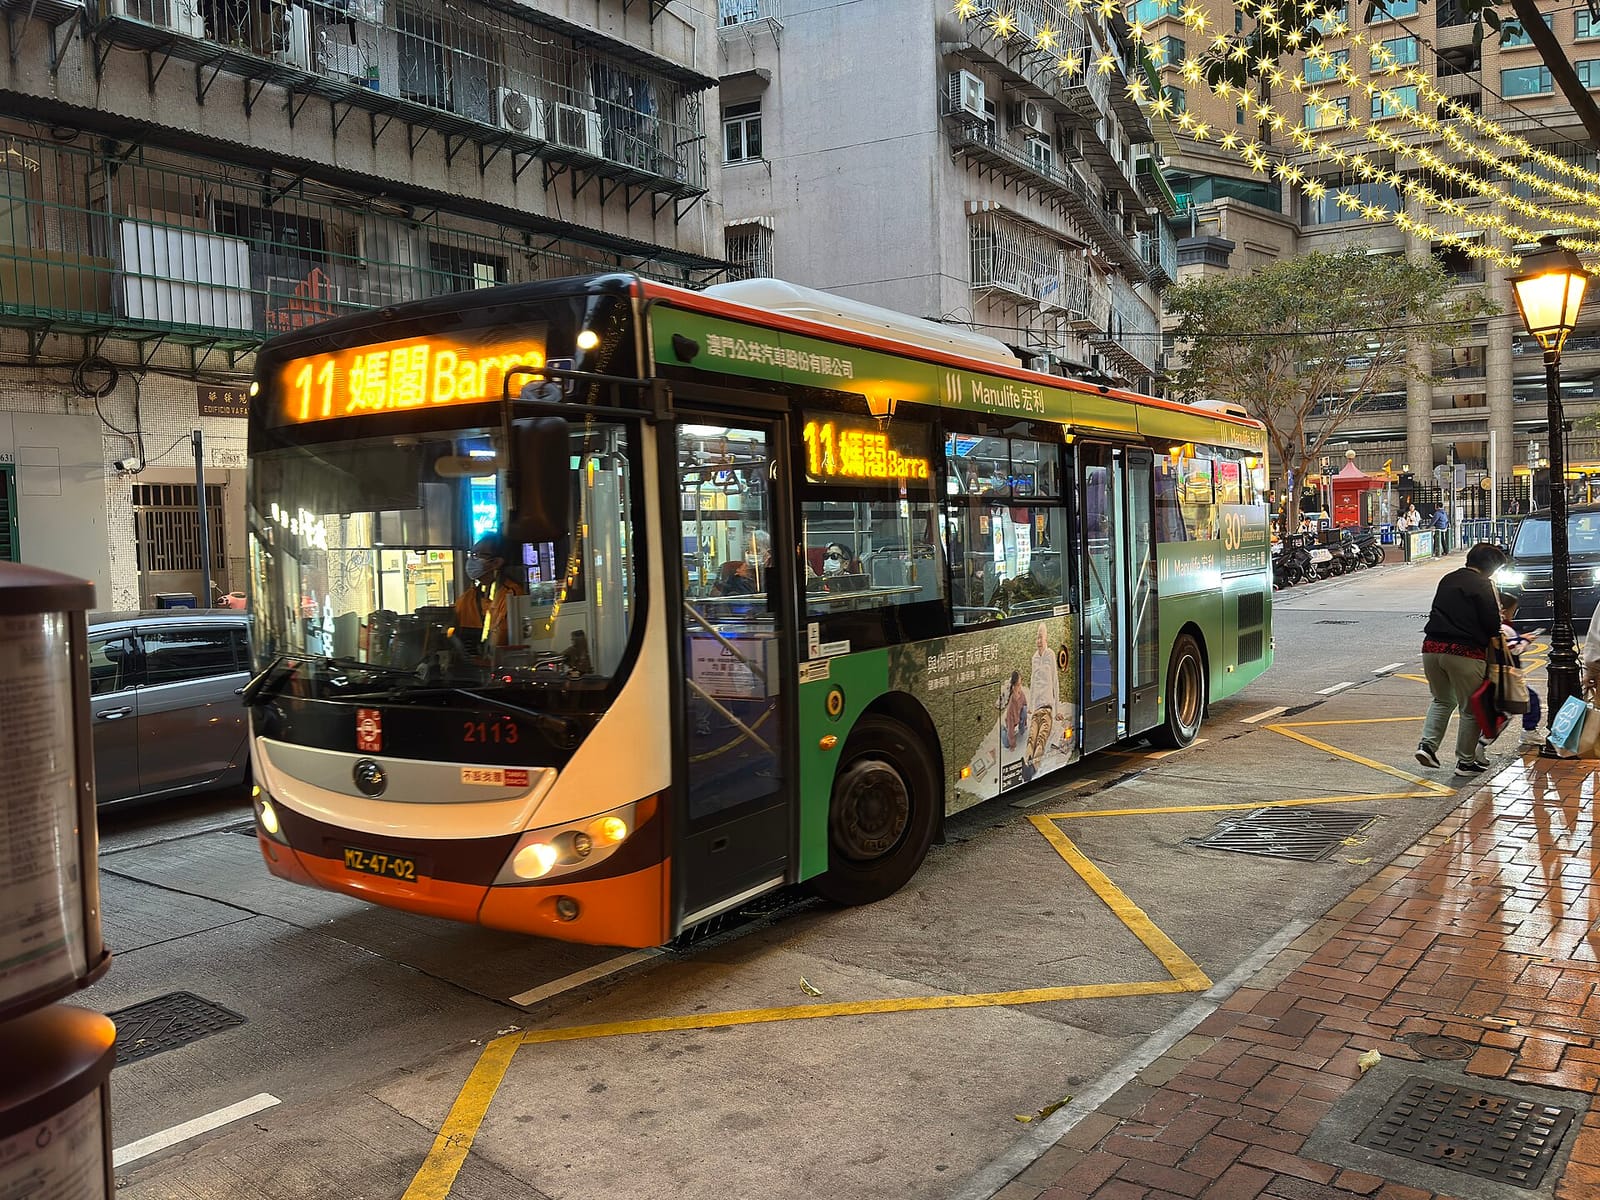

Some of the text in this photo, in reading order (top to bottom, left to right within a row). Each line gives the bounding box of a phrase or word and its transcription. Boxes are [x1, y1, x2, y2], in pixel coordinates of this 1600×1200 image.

[706, 334, 853, 378] 澳門公共汽車股份有限公司
[295, 360, 336, 419] 11
[346, 344, 430, 413] 媽閣
[971, 380, 1045, 413] Manulife 宏利
[803, 421, 928, 478] 11 媽閣 Barra
[927, 652, 965, 675] 與你同行
[463, 721, 519, 744] 2113
[344, 848, 415, 879] MZ-47-02
